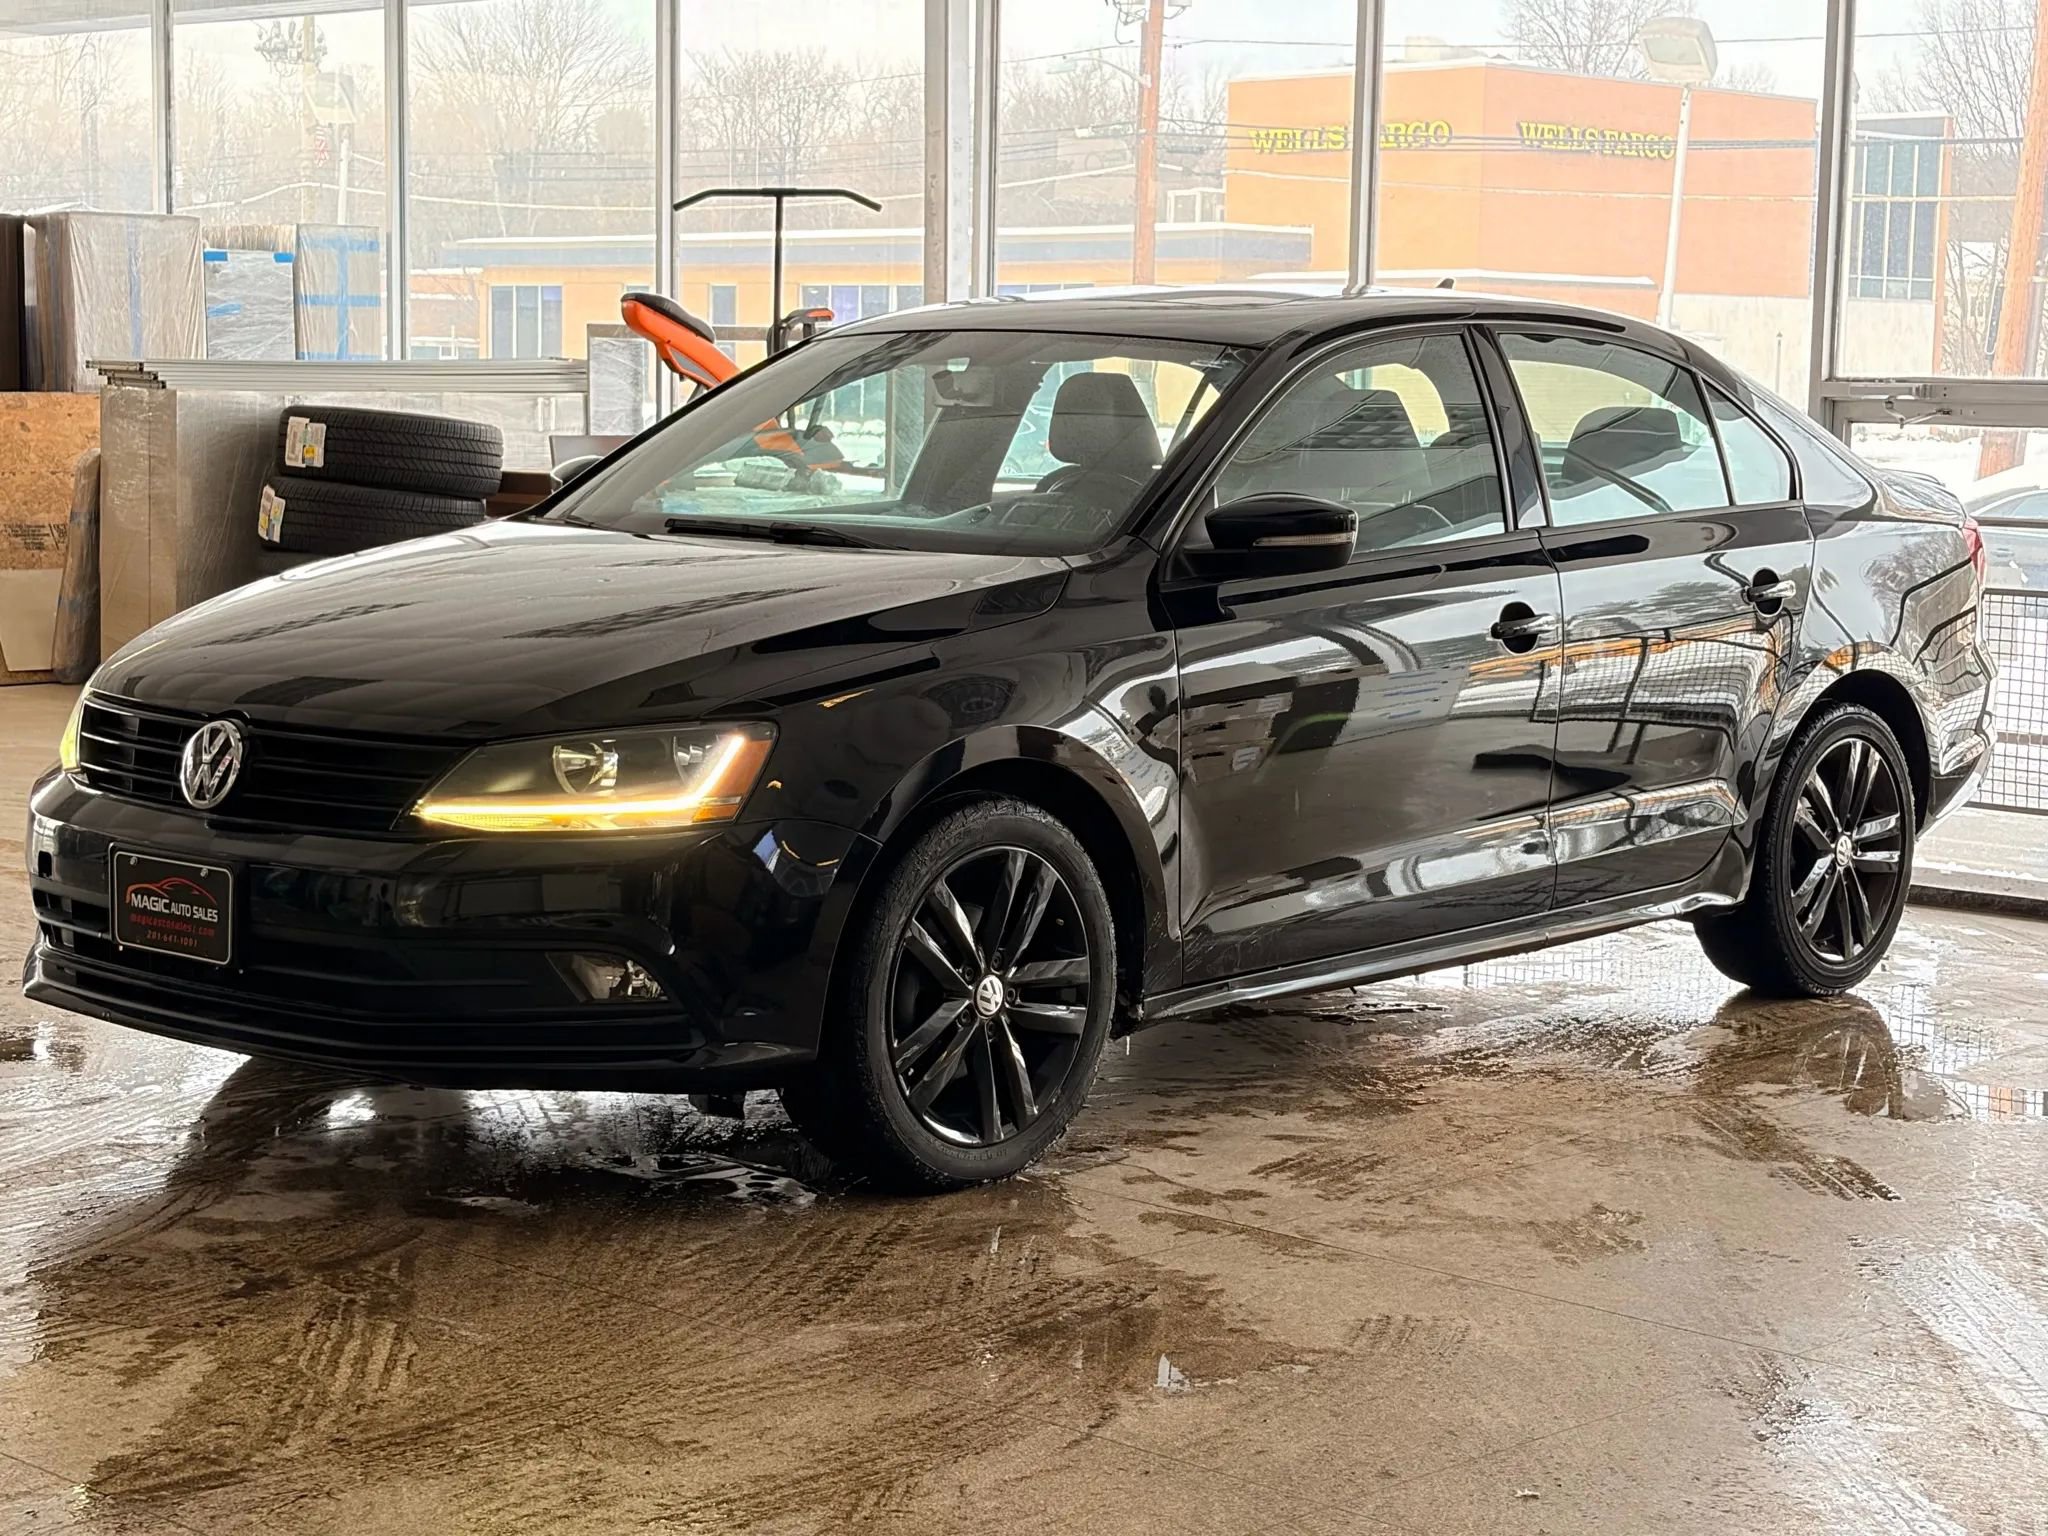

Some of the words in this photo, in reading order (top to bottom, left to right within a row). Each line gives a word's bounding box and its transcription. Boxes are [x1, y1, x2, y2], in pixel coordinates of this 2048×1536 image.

[1248, 125, 1346, 153] WELLS
[1519, 121, 1600, 152] WELLS
[1603, 129, 1676, 160] FARGO
[131, 893, 170, 914] MAGIC
[170, 902, 192, 917] AUTO
[192, 906, 218, 922] SALES
